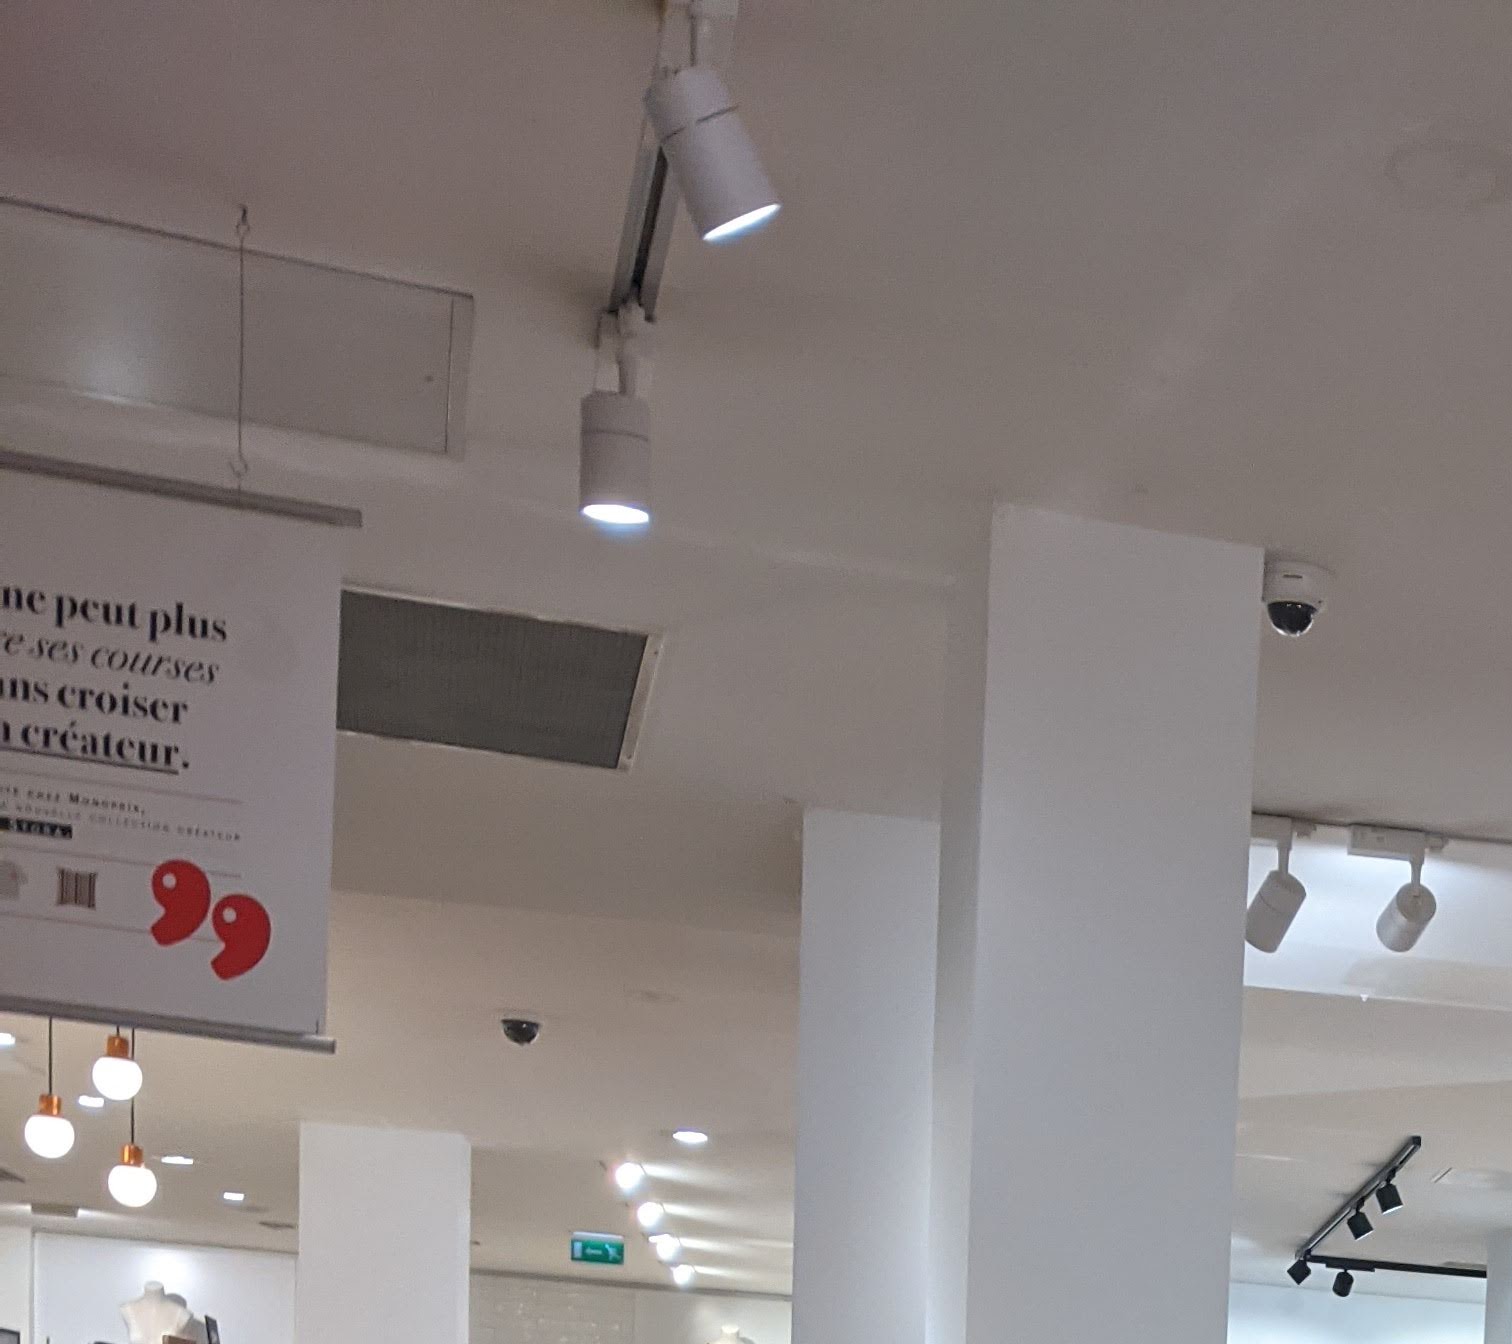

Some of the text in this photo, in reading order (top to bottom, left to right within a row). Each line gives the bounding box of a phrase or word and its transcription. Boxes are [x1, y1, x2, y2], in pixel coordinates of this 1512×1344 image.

[2, 586, 228, 642] ne peut plus
[29, 636, 83, 664] ses
[90, 647, 220, 685] courses
[0, 676, 188, 725] ns croiser
[21, 719, 190, 769] créateur.
